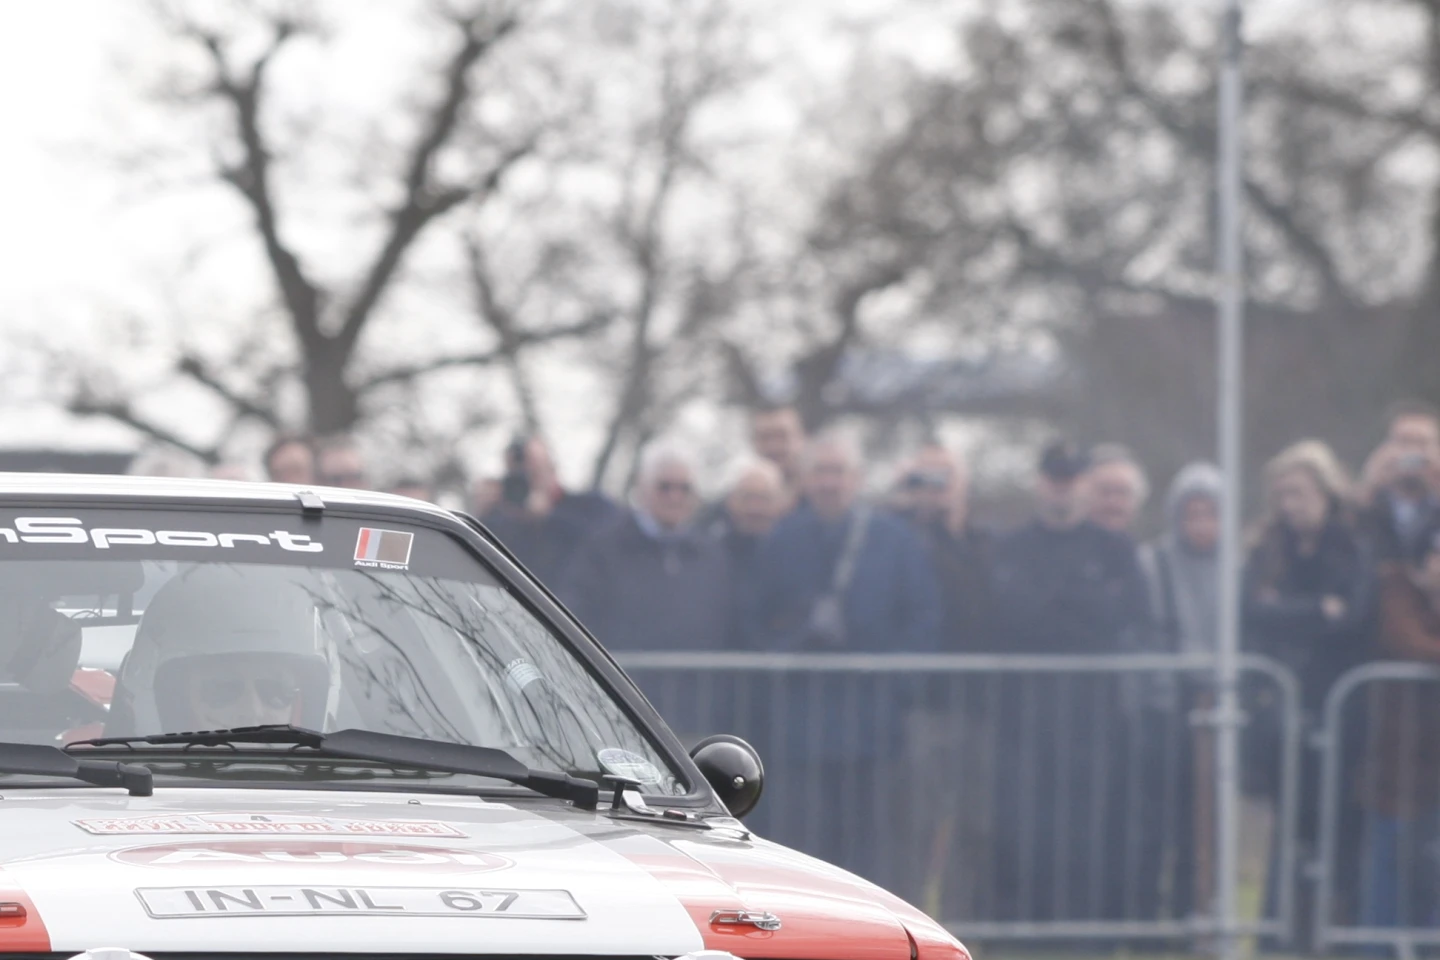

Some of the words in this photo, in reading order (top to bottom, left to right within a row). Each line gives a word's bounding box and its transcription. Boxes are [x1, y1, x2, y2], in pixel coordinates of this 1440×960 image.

[354, 560, 377, 568] Audi
[379, 561, 409, 570] Sport
[184, 888, 405, 911] IN-NL
[438, 891, 520, 913] 67
